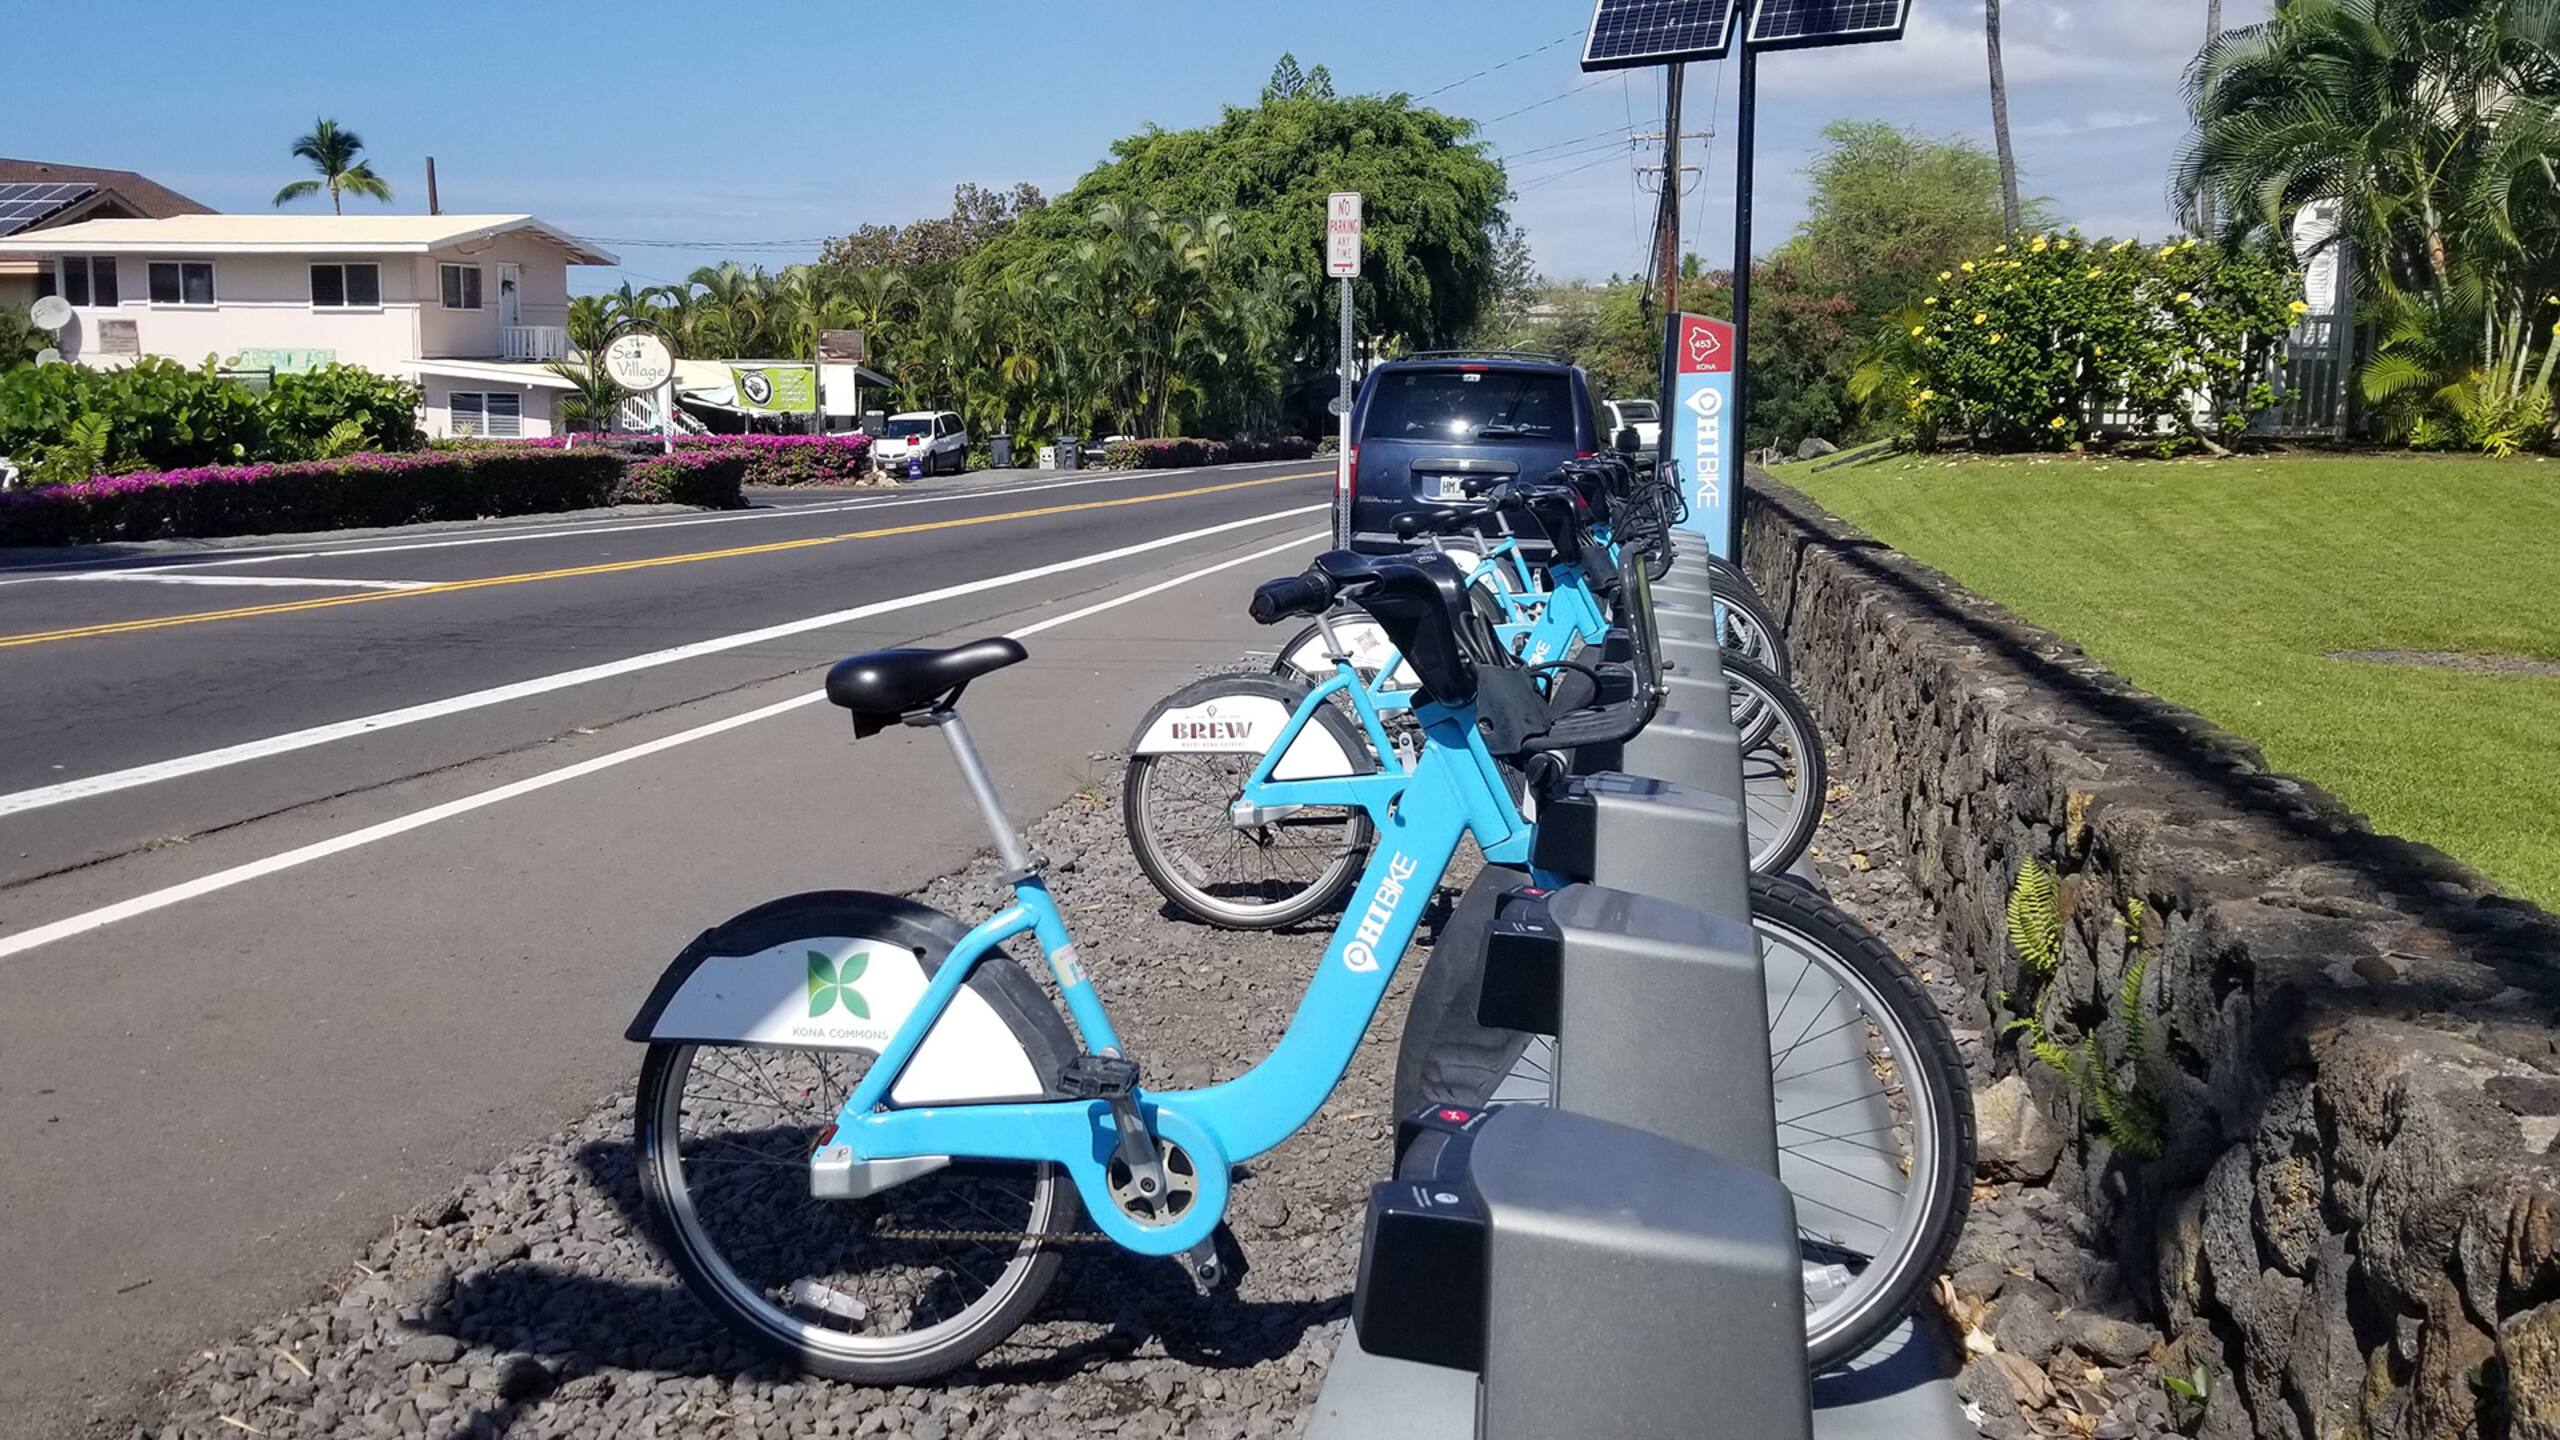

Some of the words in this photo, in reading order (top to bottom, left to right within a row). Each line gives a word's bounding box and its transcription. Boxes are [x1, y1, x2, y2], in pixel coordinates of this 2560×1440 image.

[1338, 200, 1351, 216] NO
[1330, 219, 1357, 234] PARKING
[1338, 237, 1350, 246] ANY
[1336, 248, 1352, 259] TIME
[628, 337, 646, 348] The
[1694, 339, 1712, 349] 453
[612, 344, 642, 359] Sea
[617, 361, 666, 382] Village
[1696, 363, 1717, 371] KONA
[1696, 416, 1720, 509] HIBIKE
[1172, 721, 1253, 740] BREW
[1355, 850, 1418, 949] HIBIKE
[792, 1026, 825, 1038] KONA
[829, 1028, 888, 1041] COMMONS
